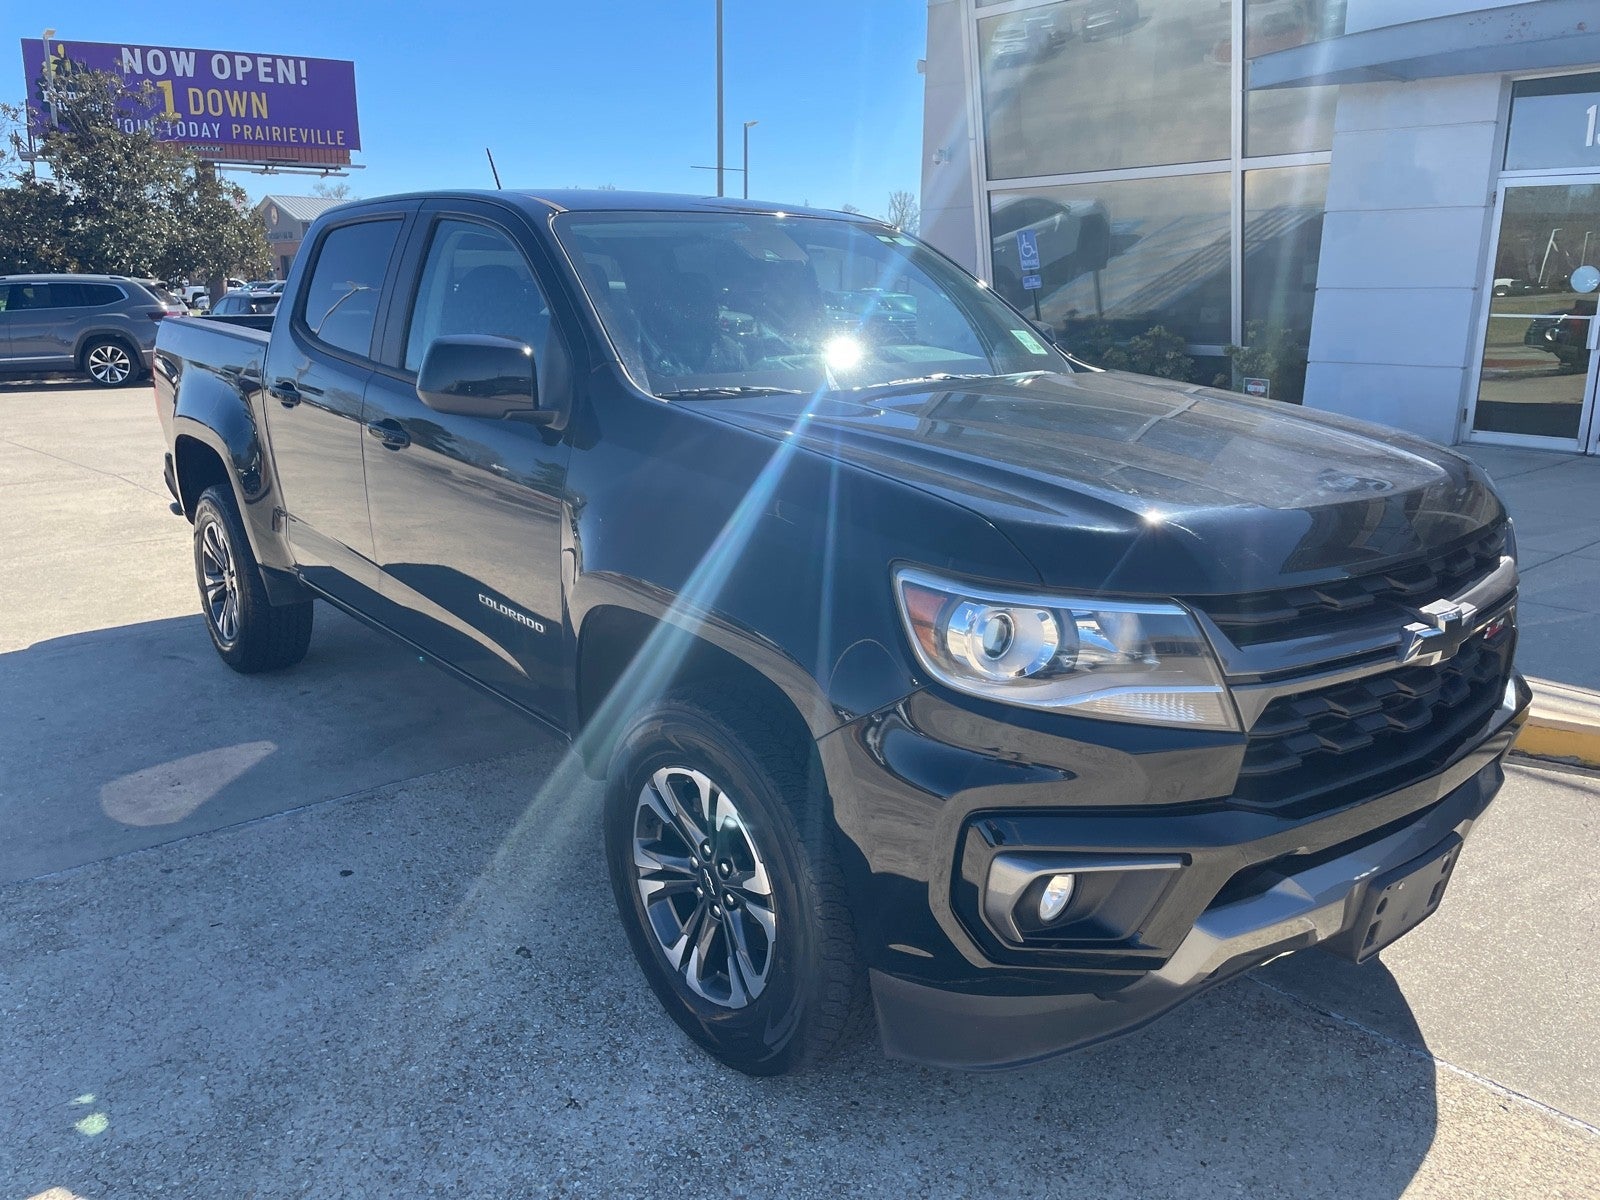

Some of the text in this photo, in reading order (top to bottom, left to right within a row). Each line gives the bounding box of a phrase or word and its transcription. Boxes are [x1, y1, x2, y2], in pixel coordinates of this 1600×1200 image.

[121, 47, 308, 86] NOW OPEN!
[187, 87, 269, 119] DOWN
[166, 119, 221, 139] TODAY
[231, 124, 346, 146] PRAIRIEVILLE
[1585, 104, 1600, 147] 1
[478, 593, 544, 633] COLORADO
